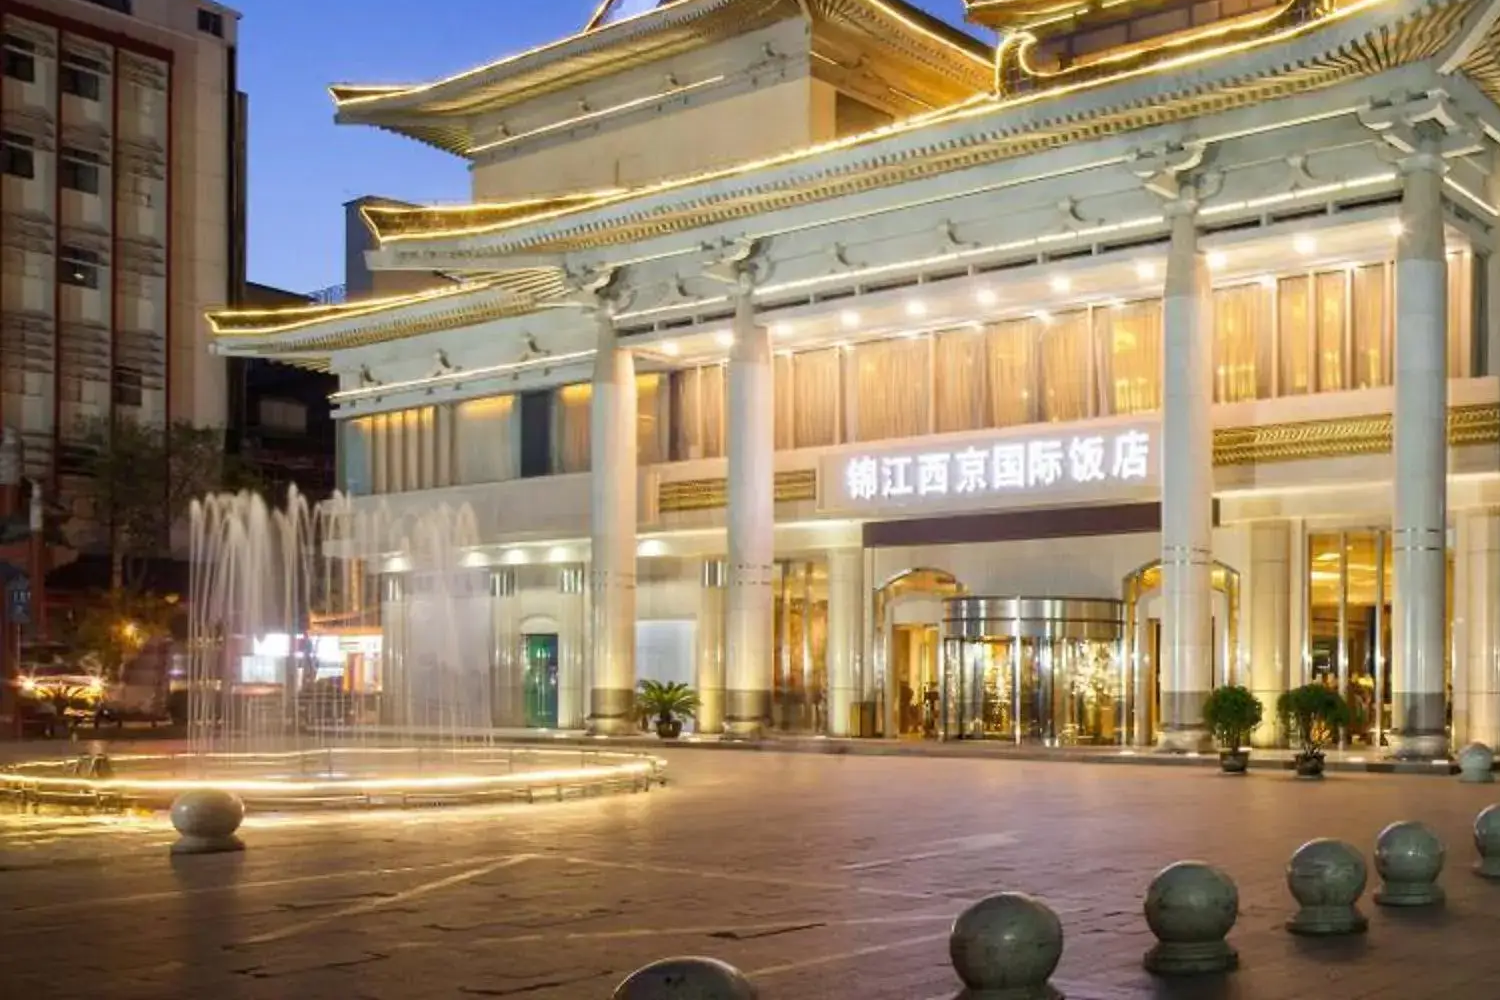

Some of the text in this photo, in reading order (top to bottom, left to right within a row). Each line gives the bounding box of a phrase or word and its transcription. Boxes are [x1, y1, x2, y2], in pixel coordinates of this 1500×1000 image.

[848, 430, 1149, 499] 锦江西京国际饭店
